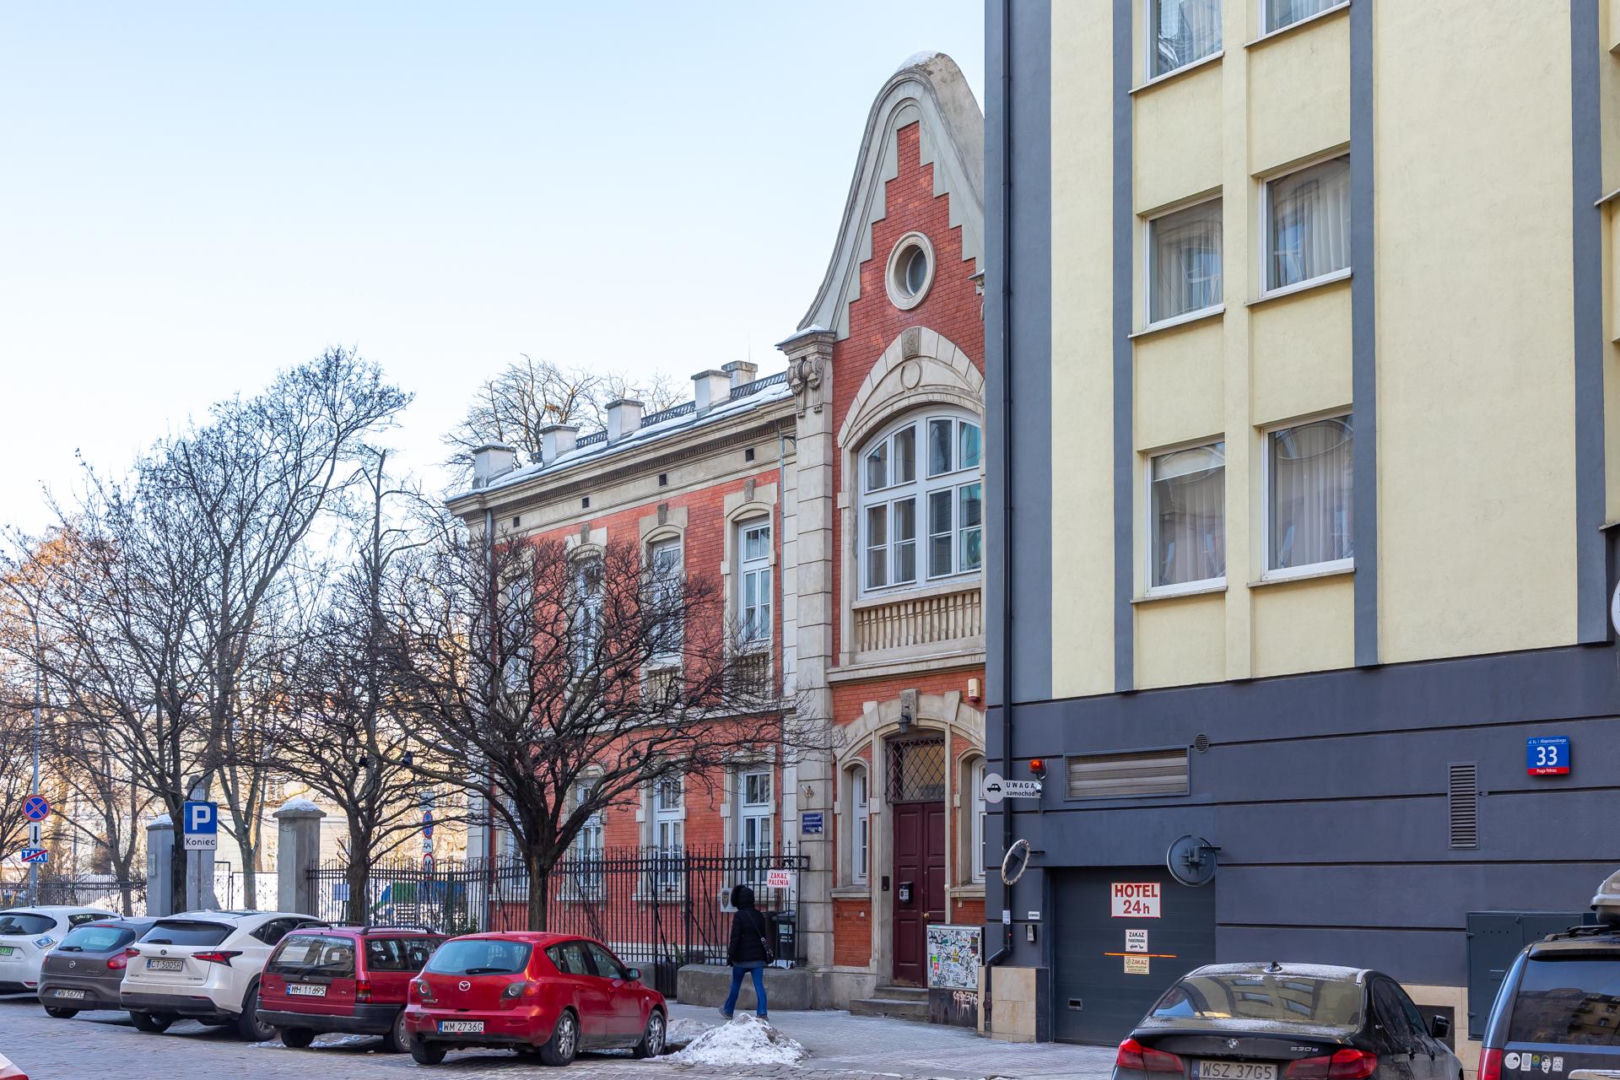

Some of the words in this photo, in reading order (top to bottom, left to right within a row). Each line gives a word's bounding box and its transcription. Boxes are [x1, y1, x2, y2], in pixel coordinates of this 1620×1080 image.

[1536, 746, 1558, 766] 33
[192, 805, 211, 831] P
[186, 838, 216, 846] Koniec
[23, 850, 48, 861] TAXI
[1114, 884, 1159, 898] HOTEL
[1123, 899, 1150, 914] 24h
[443, 1022, 455, 1032] WM
[457, 1022, 483, 1032] 2736G
[1203, 1063, 1230, 1078] WSZ
[1237, 1064, 1272, 1079] 37G5
